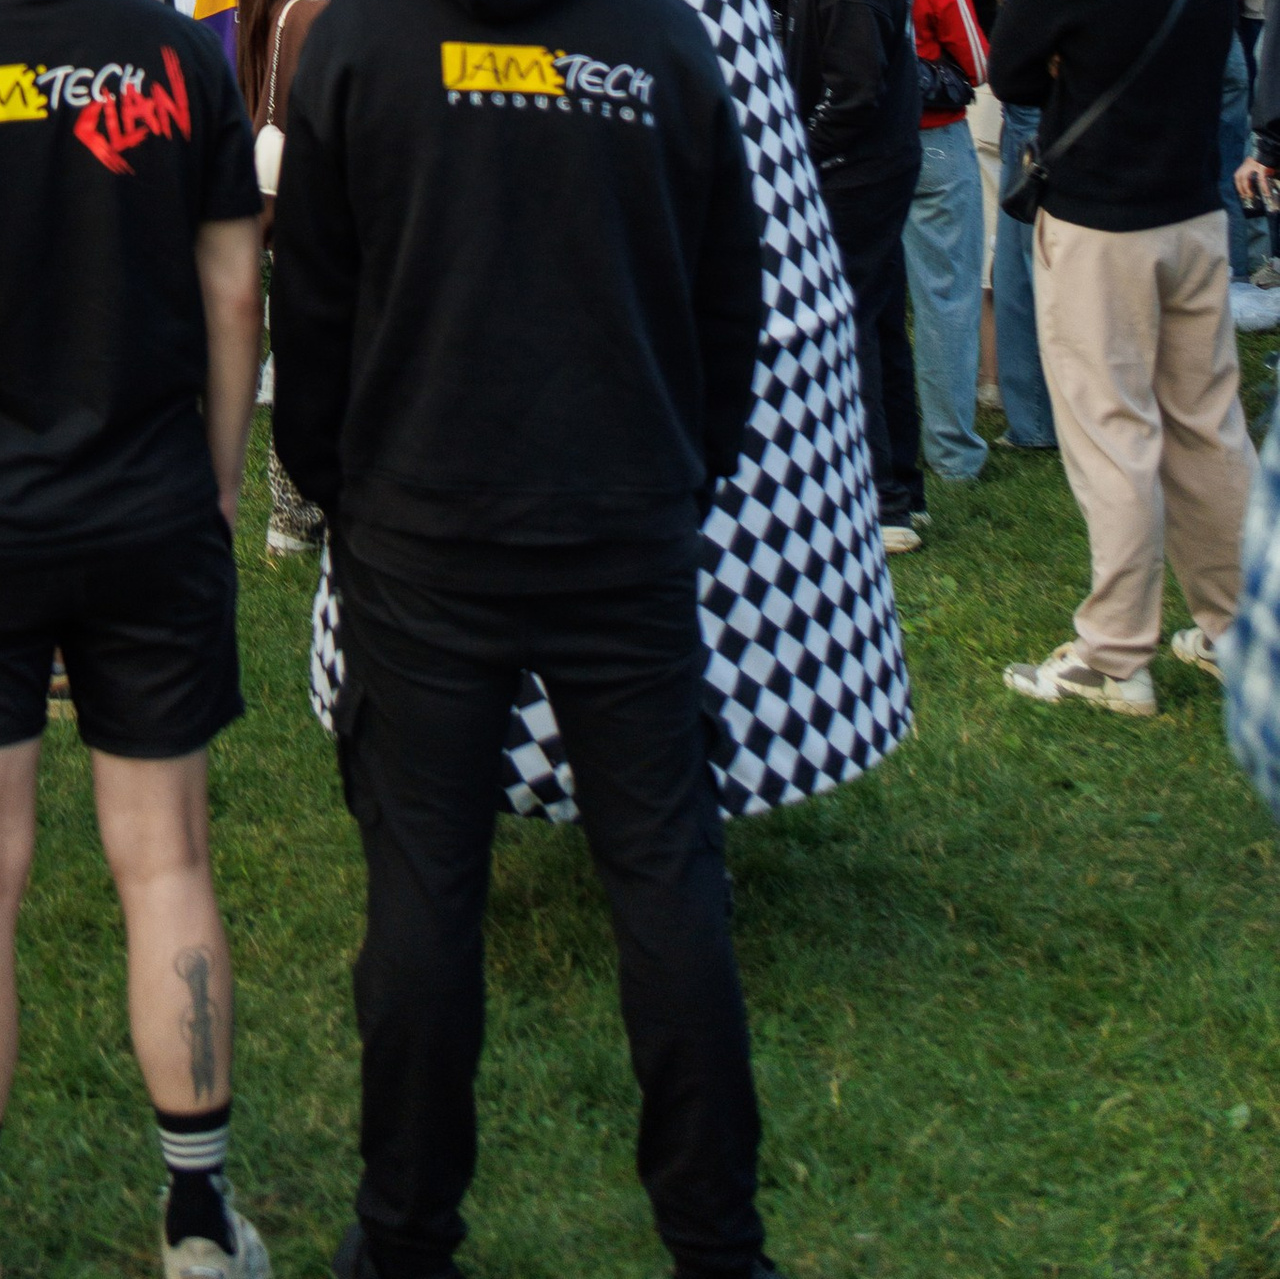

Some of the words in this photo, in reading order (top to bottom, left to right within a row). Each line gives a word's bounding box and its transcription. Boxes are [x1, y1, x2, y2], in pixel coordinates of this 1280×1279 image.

[553, 53, 655, 105] TECH
[73, 44, 192, 176] CLAN
[447, 89, 655, 128] PRODUCTION
